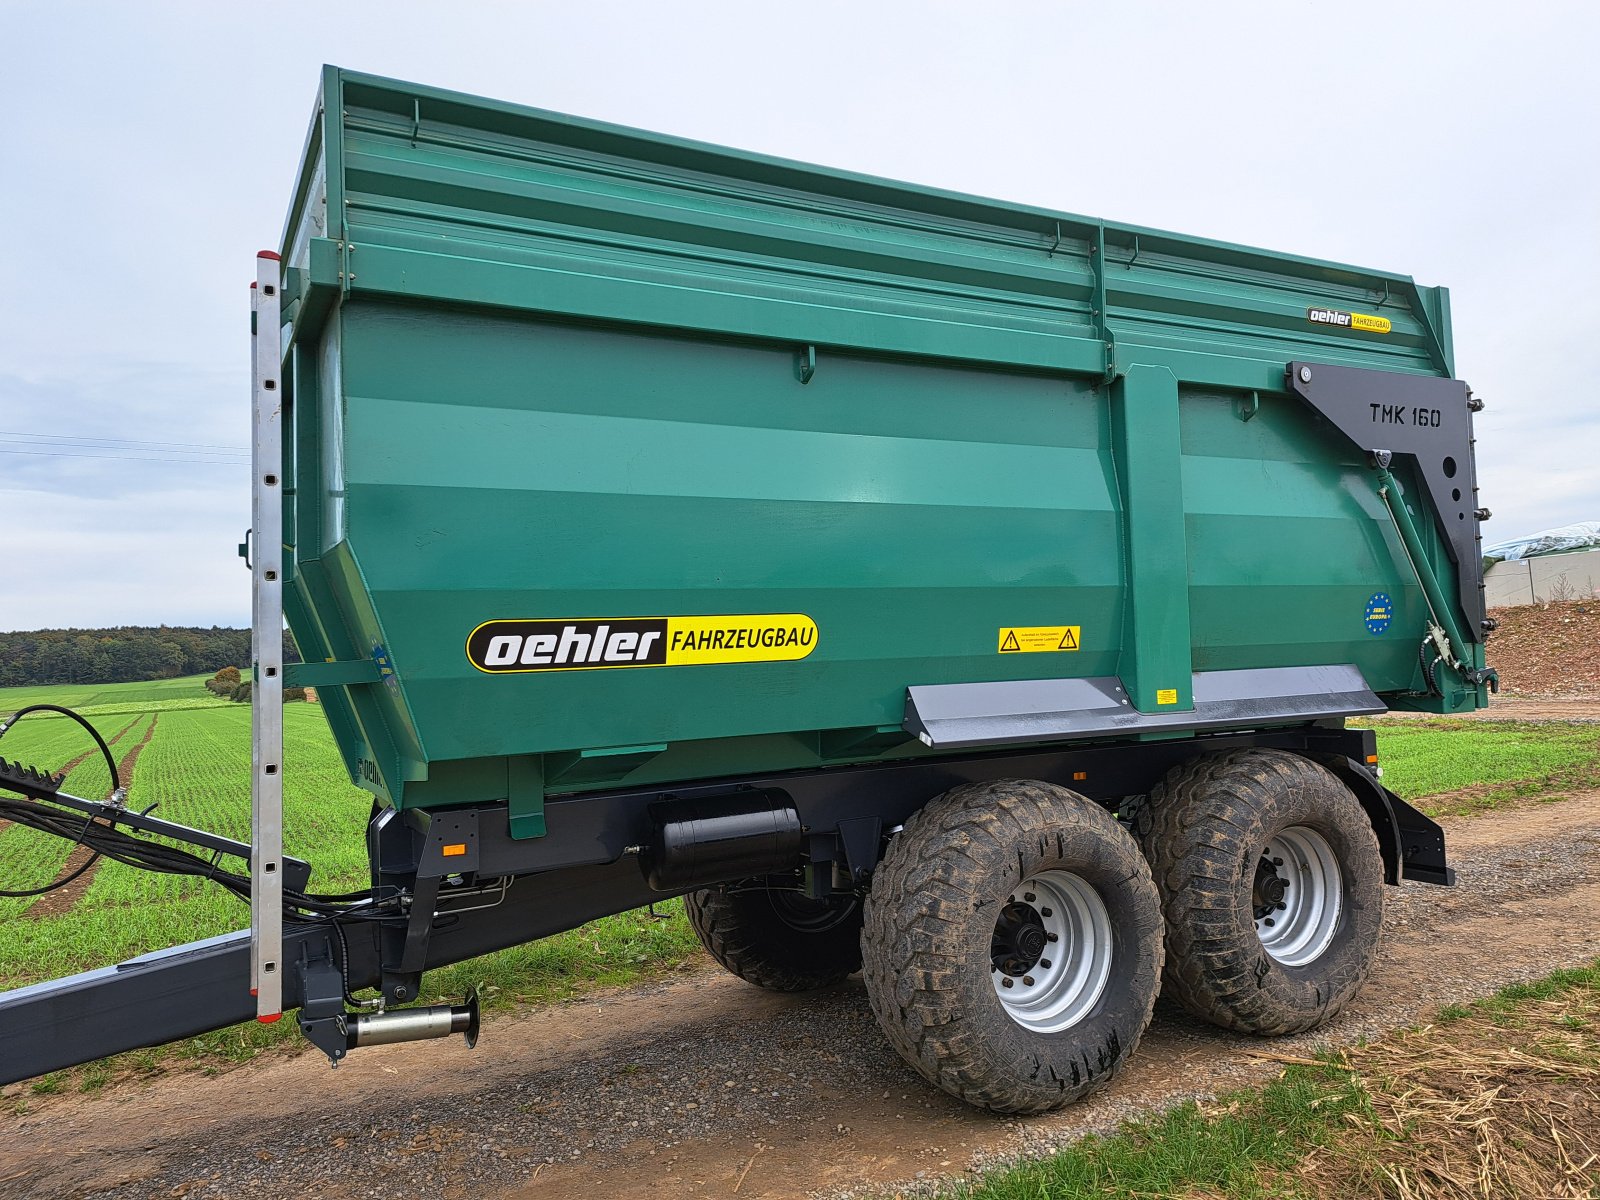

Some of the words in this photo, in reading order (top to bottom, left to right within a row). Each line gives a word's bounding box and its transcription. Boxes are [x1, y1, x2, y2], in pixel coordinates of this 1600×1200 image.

[1310, 310, 1350, 325] oehler
[1353, 316, 1389, 329] FAHRZEUGBAU
[1369, 403, 1406, 425] TMK
[1412, 407, 1441, 428] 160
[484, 626, 661, 665] oehler
[671, 627, 814, 651] FAHRZEUGBAU
